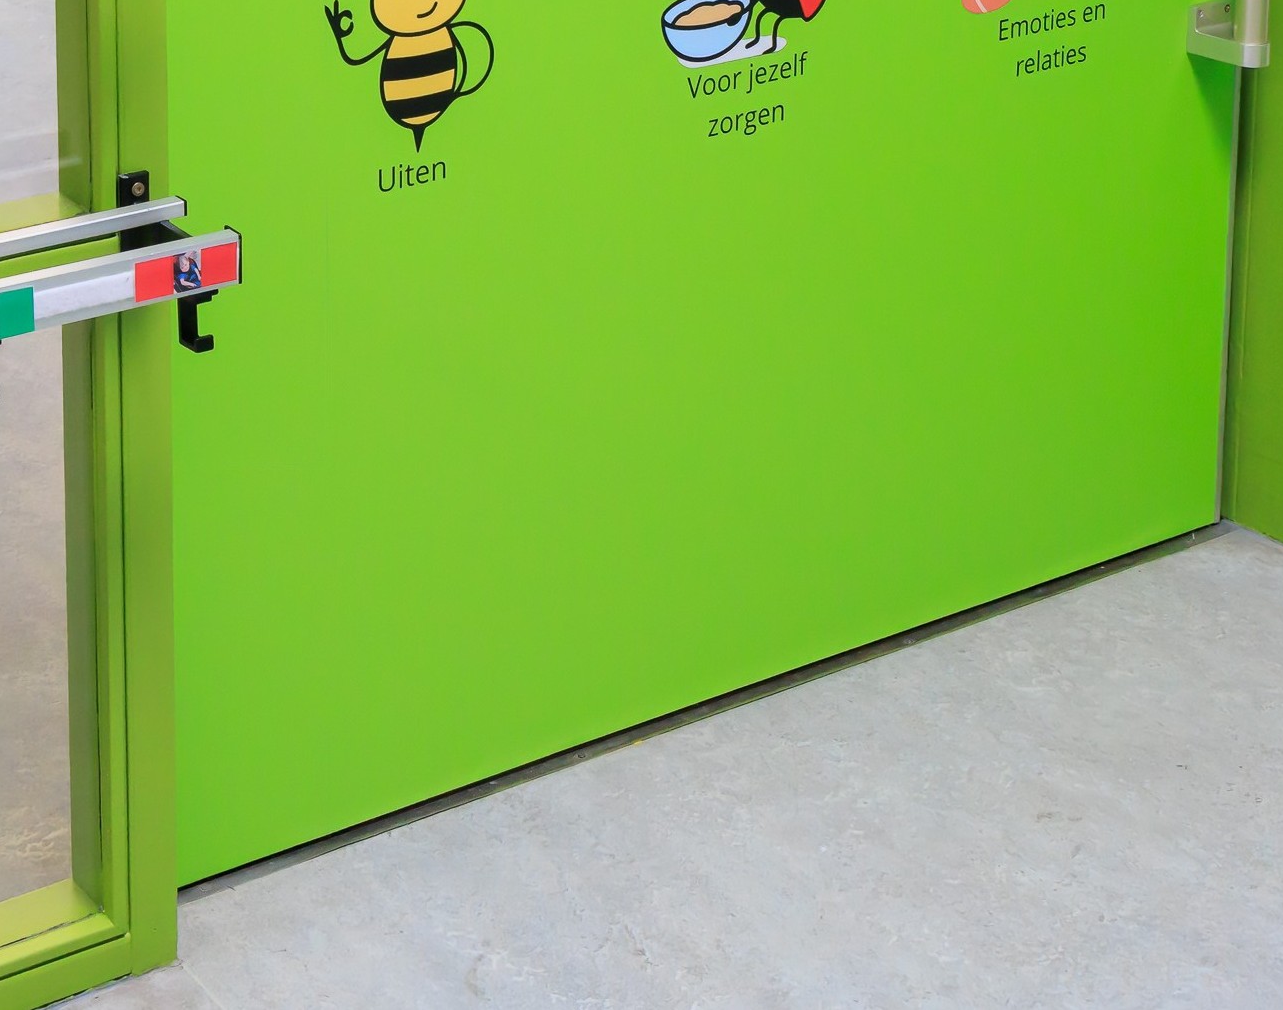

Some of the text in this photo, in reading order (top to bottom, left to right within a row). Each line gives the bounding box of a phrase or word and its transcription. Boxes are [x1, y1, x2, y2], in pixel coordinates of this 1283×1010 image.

[998, 3, 1106, 42] Emoties en
[687, 50, 809, 99] Voor jezelf
[1016, 45, 1087, 77] relaties
[707, 104, 785, 138] zorgen
[378, 161, 446, 193] Uiten
